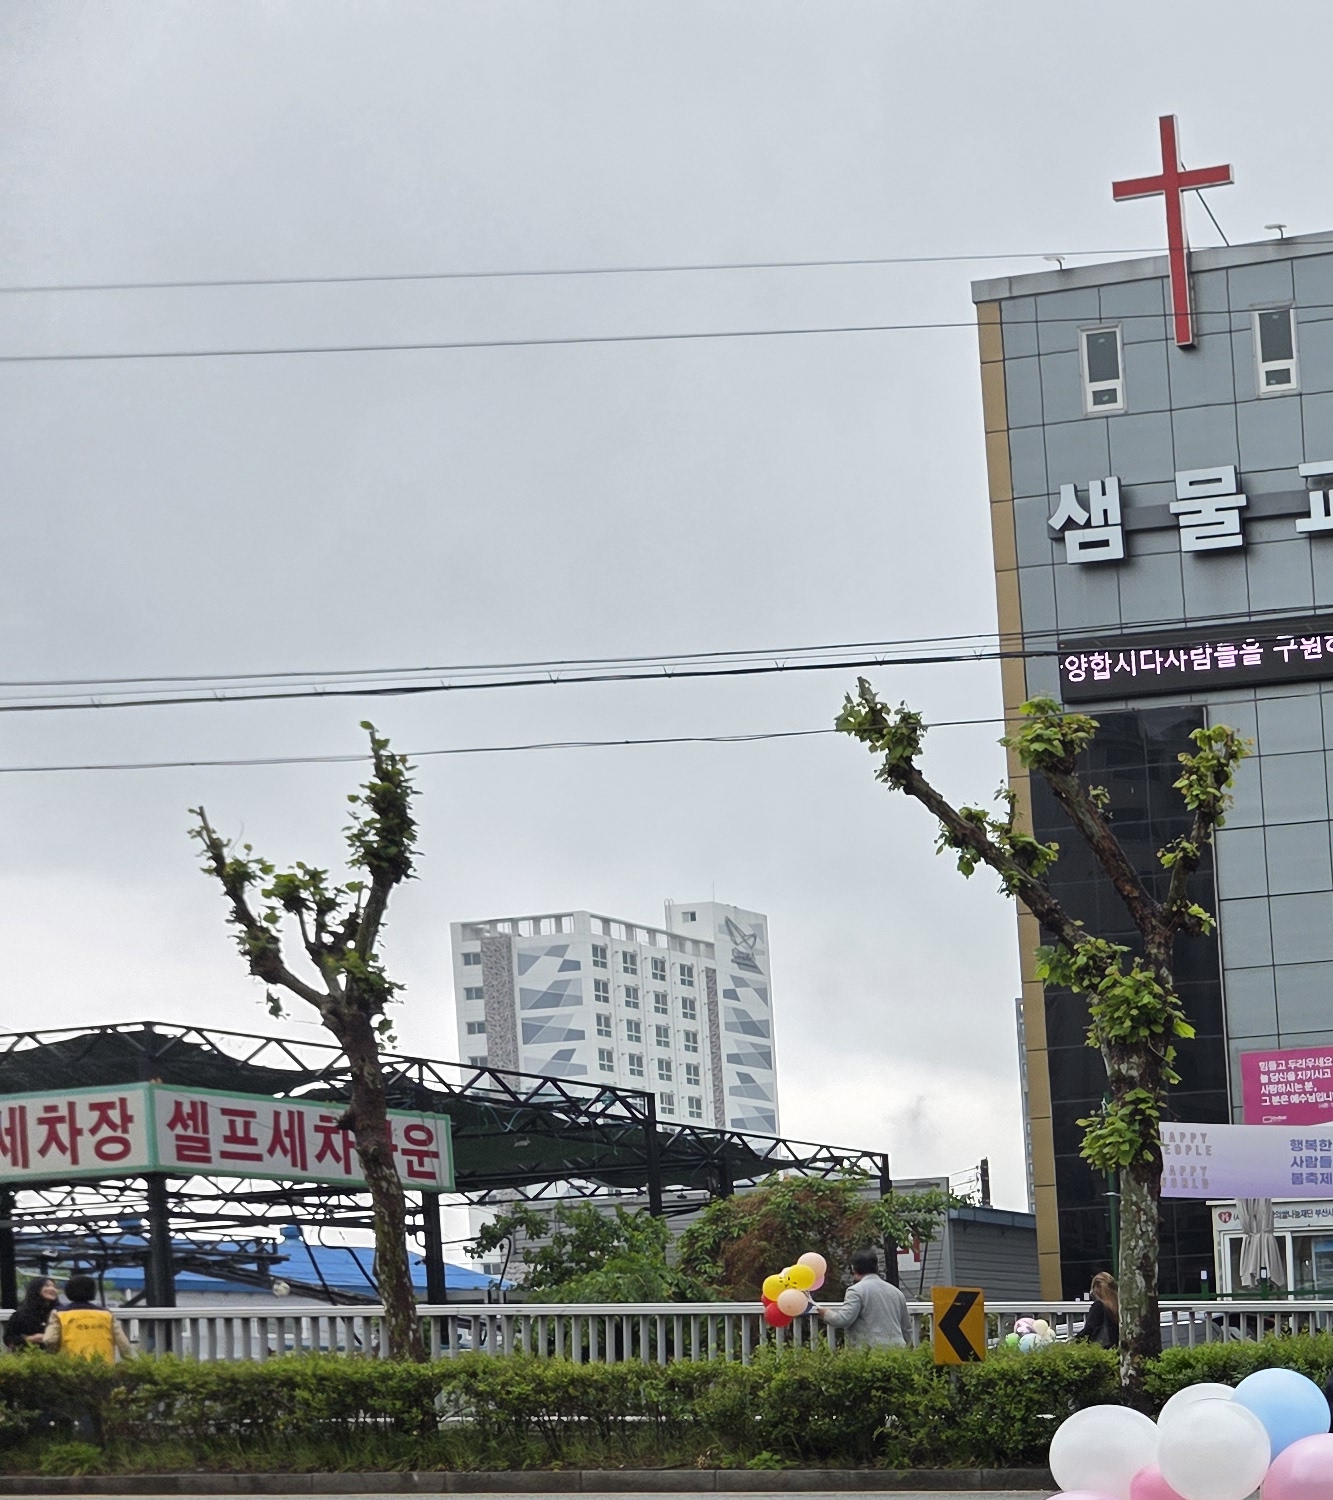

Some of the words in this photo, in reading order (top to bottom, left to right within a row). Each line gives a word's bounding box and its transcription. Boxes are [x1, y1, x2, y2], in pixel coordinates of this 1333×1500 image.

[167, 1100, 440, 1181] 셀프세차운
[1290, 1138, 1333, 1152] 행복한
[1164, 1143, 1212, 1156] EOPLE
[1163, 1165, 1208, 1177] APPY
